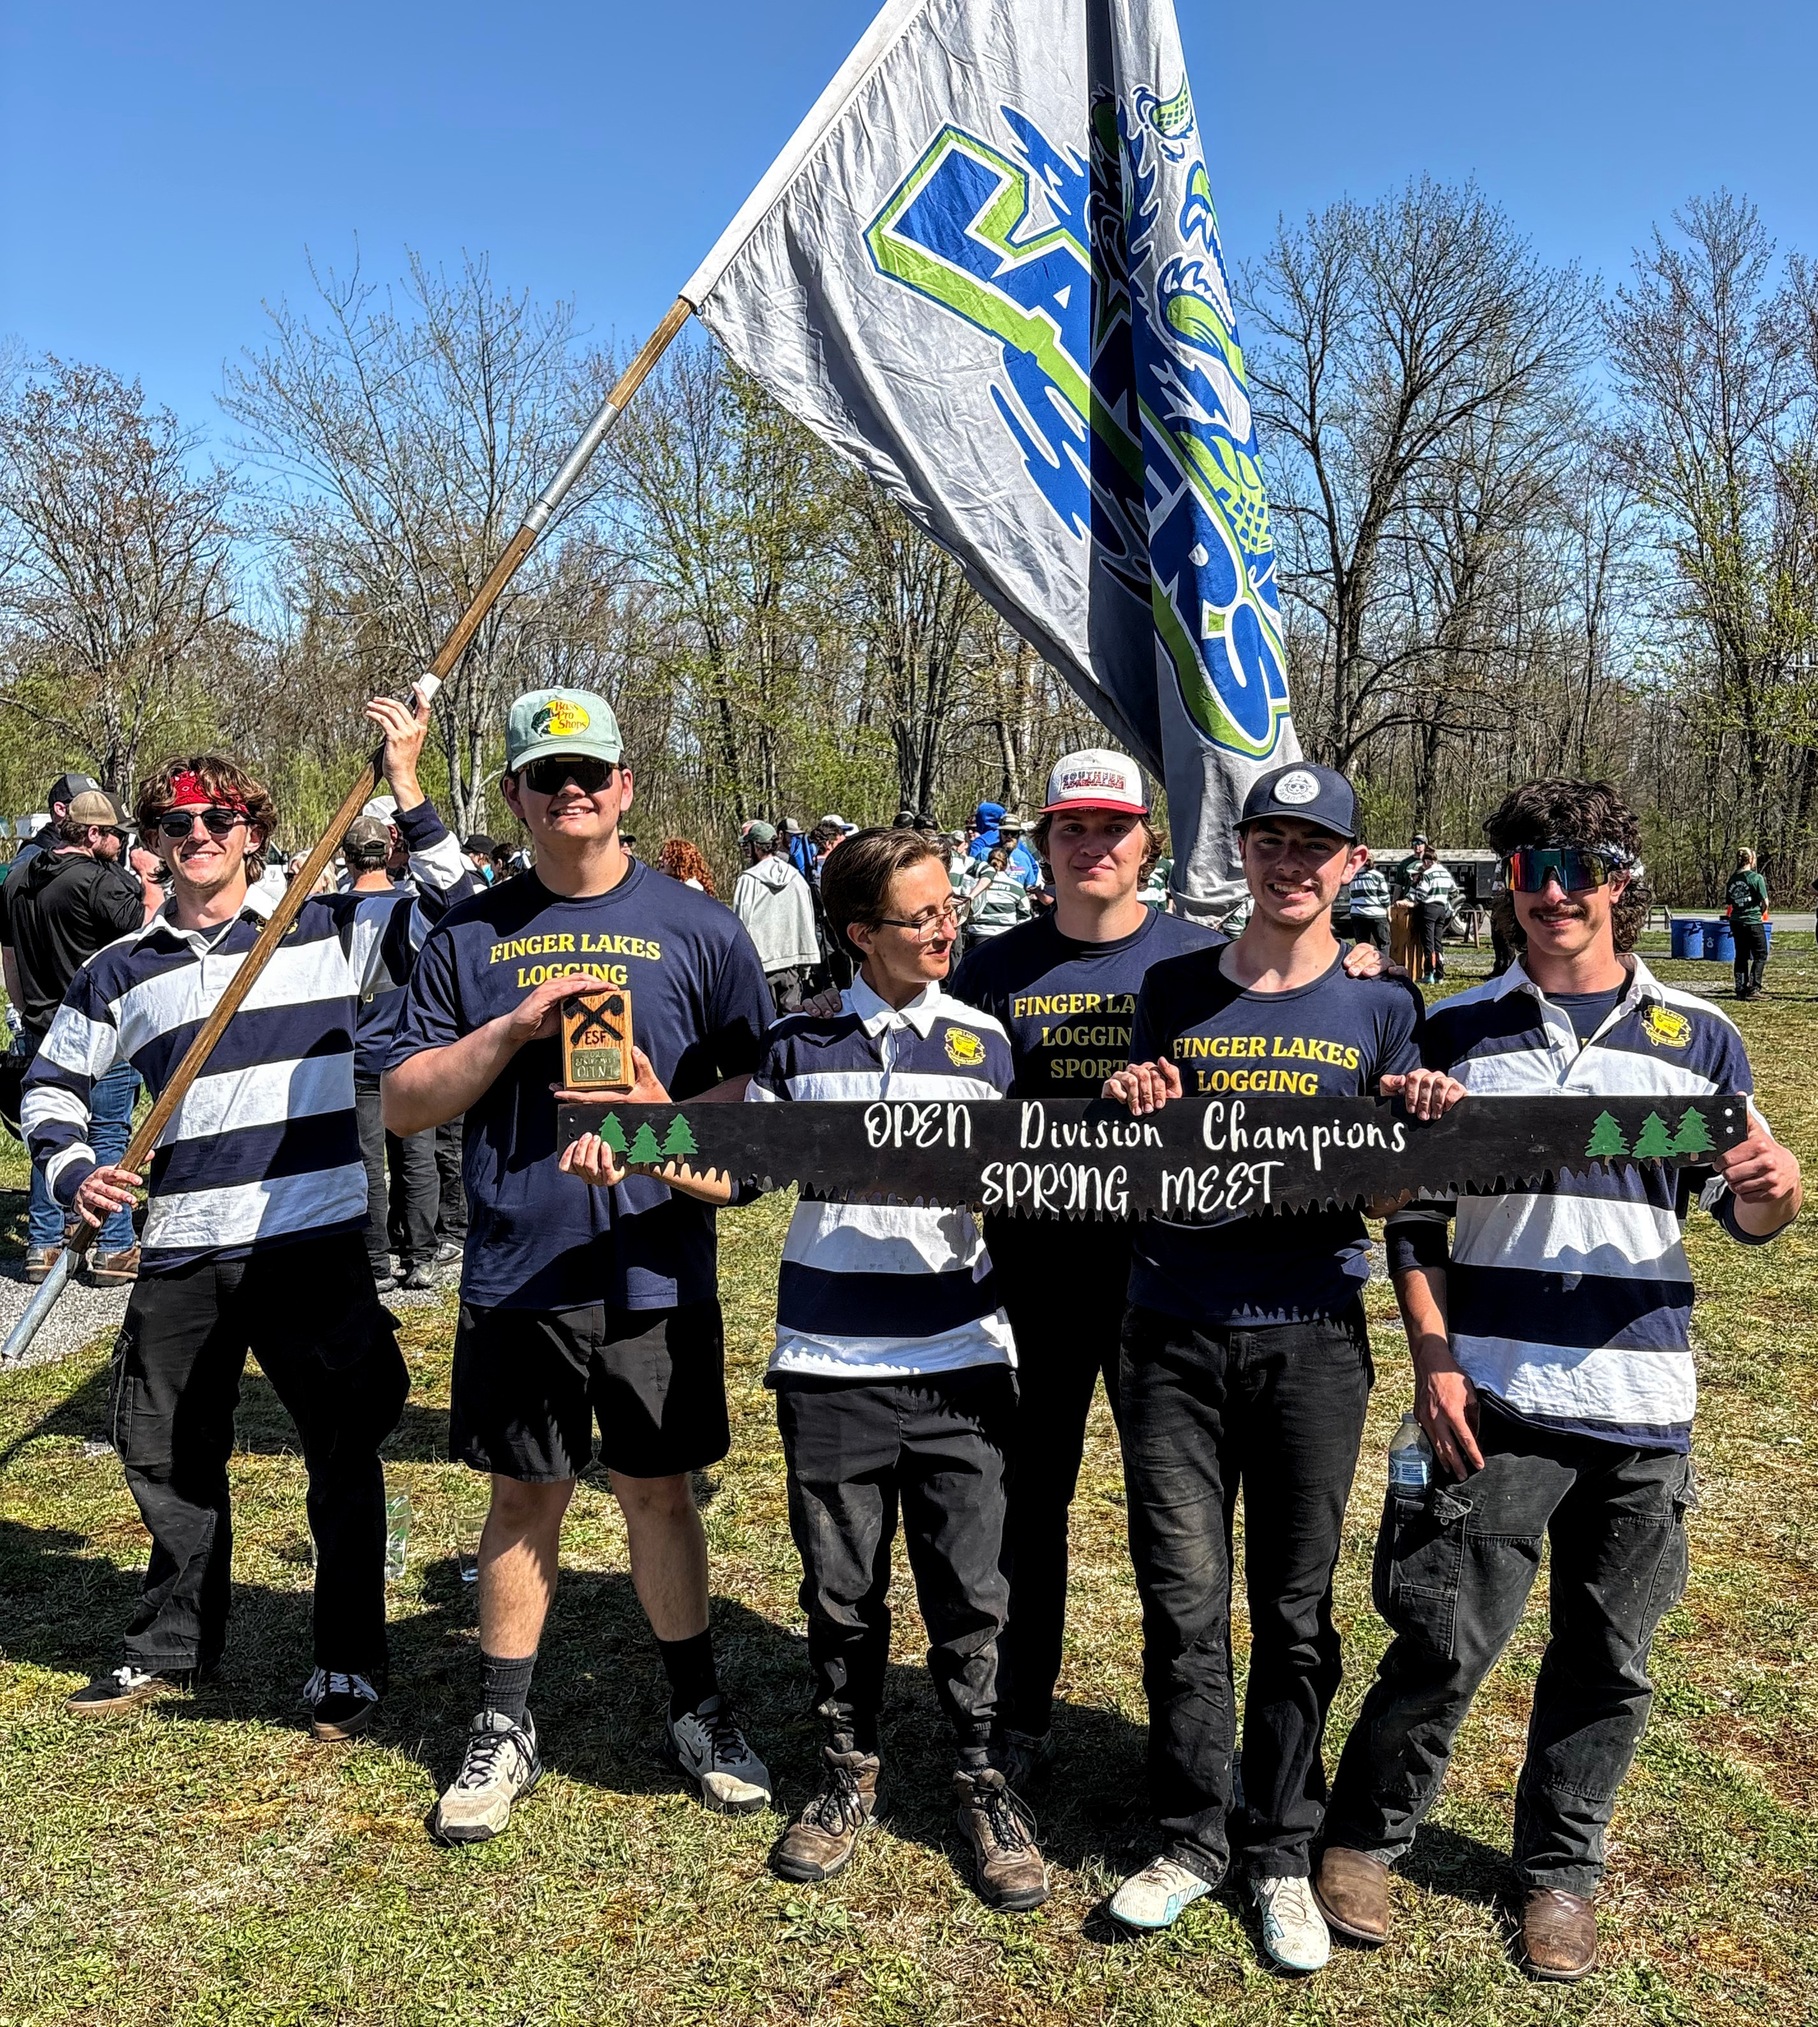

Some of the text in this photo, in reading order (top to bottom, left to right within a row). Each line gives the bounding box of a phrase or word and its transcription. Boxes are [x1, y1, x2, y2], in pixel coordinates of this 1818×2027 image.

[557, 711, 574, 720] Pro
[558, 720, 587, 729] Shops
[489, 933, 662, 964] FINGER LAKES
[517, 963, 629, 988] LOGGING
[1014, 993, 1101, 1018] FINGER
[584, 1030, 607, 1046] ESF
[1042, 1026, 1133, 1046] LOGGIN
[1173, 1036, 1360, 1070] FINGER LAKES
[1197, 1070, 1319, 1096] LOGGING
[864, 1100, 1406, 1171] OPEN Division Champions
[980, 1160, 1285, 1217] SPRING MEET
